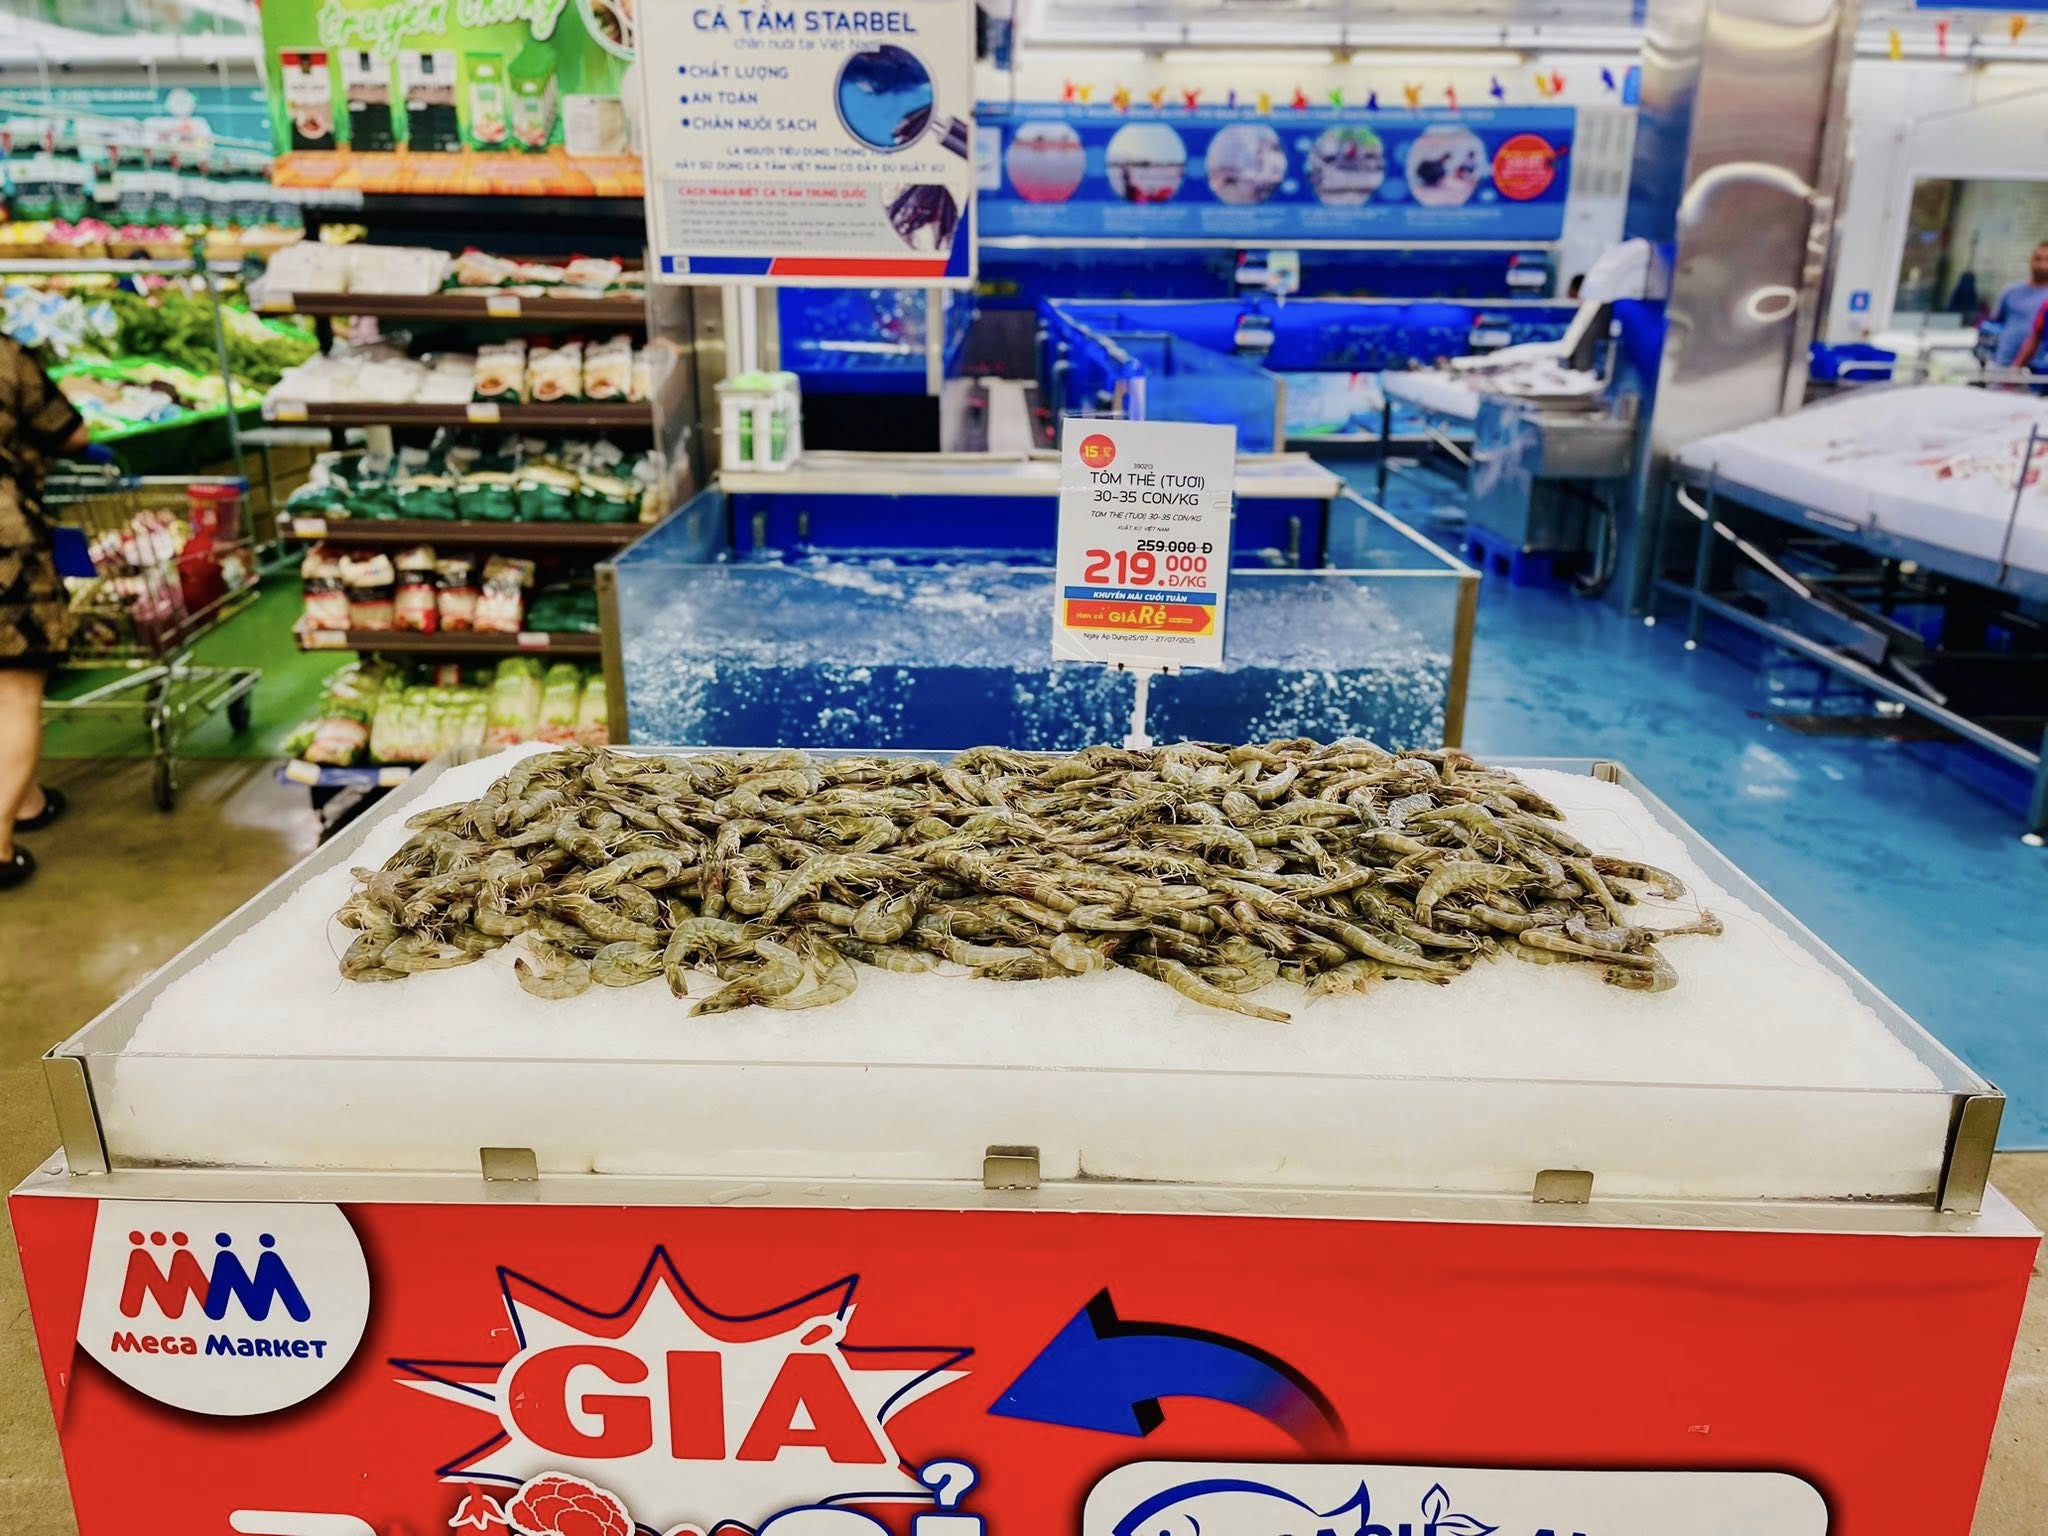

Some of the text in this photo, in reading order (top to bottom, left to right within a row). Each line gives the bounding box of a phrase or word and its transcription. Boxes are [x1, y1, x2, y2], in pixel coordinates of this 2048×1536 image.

[804, 11, 917, 32] STARBEL
[692, 92, 712, 103] AN
[1084, 445, 1099, 458] 15
[1093, 489, 1199, 506] 30-35 CON/KG
[1148, 513, 1172, 521] 30-35
[1136, 539, 1196, 553] 259.000
[1108, 609, 1138, 624] GIÁ
[508, 1323, 887, 1465] GIÁ
